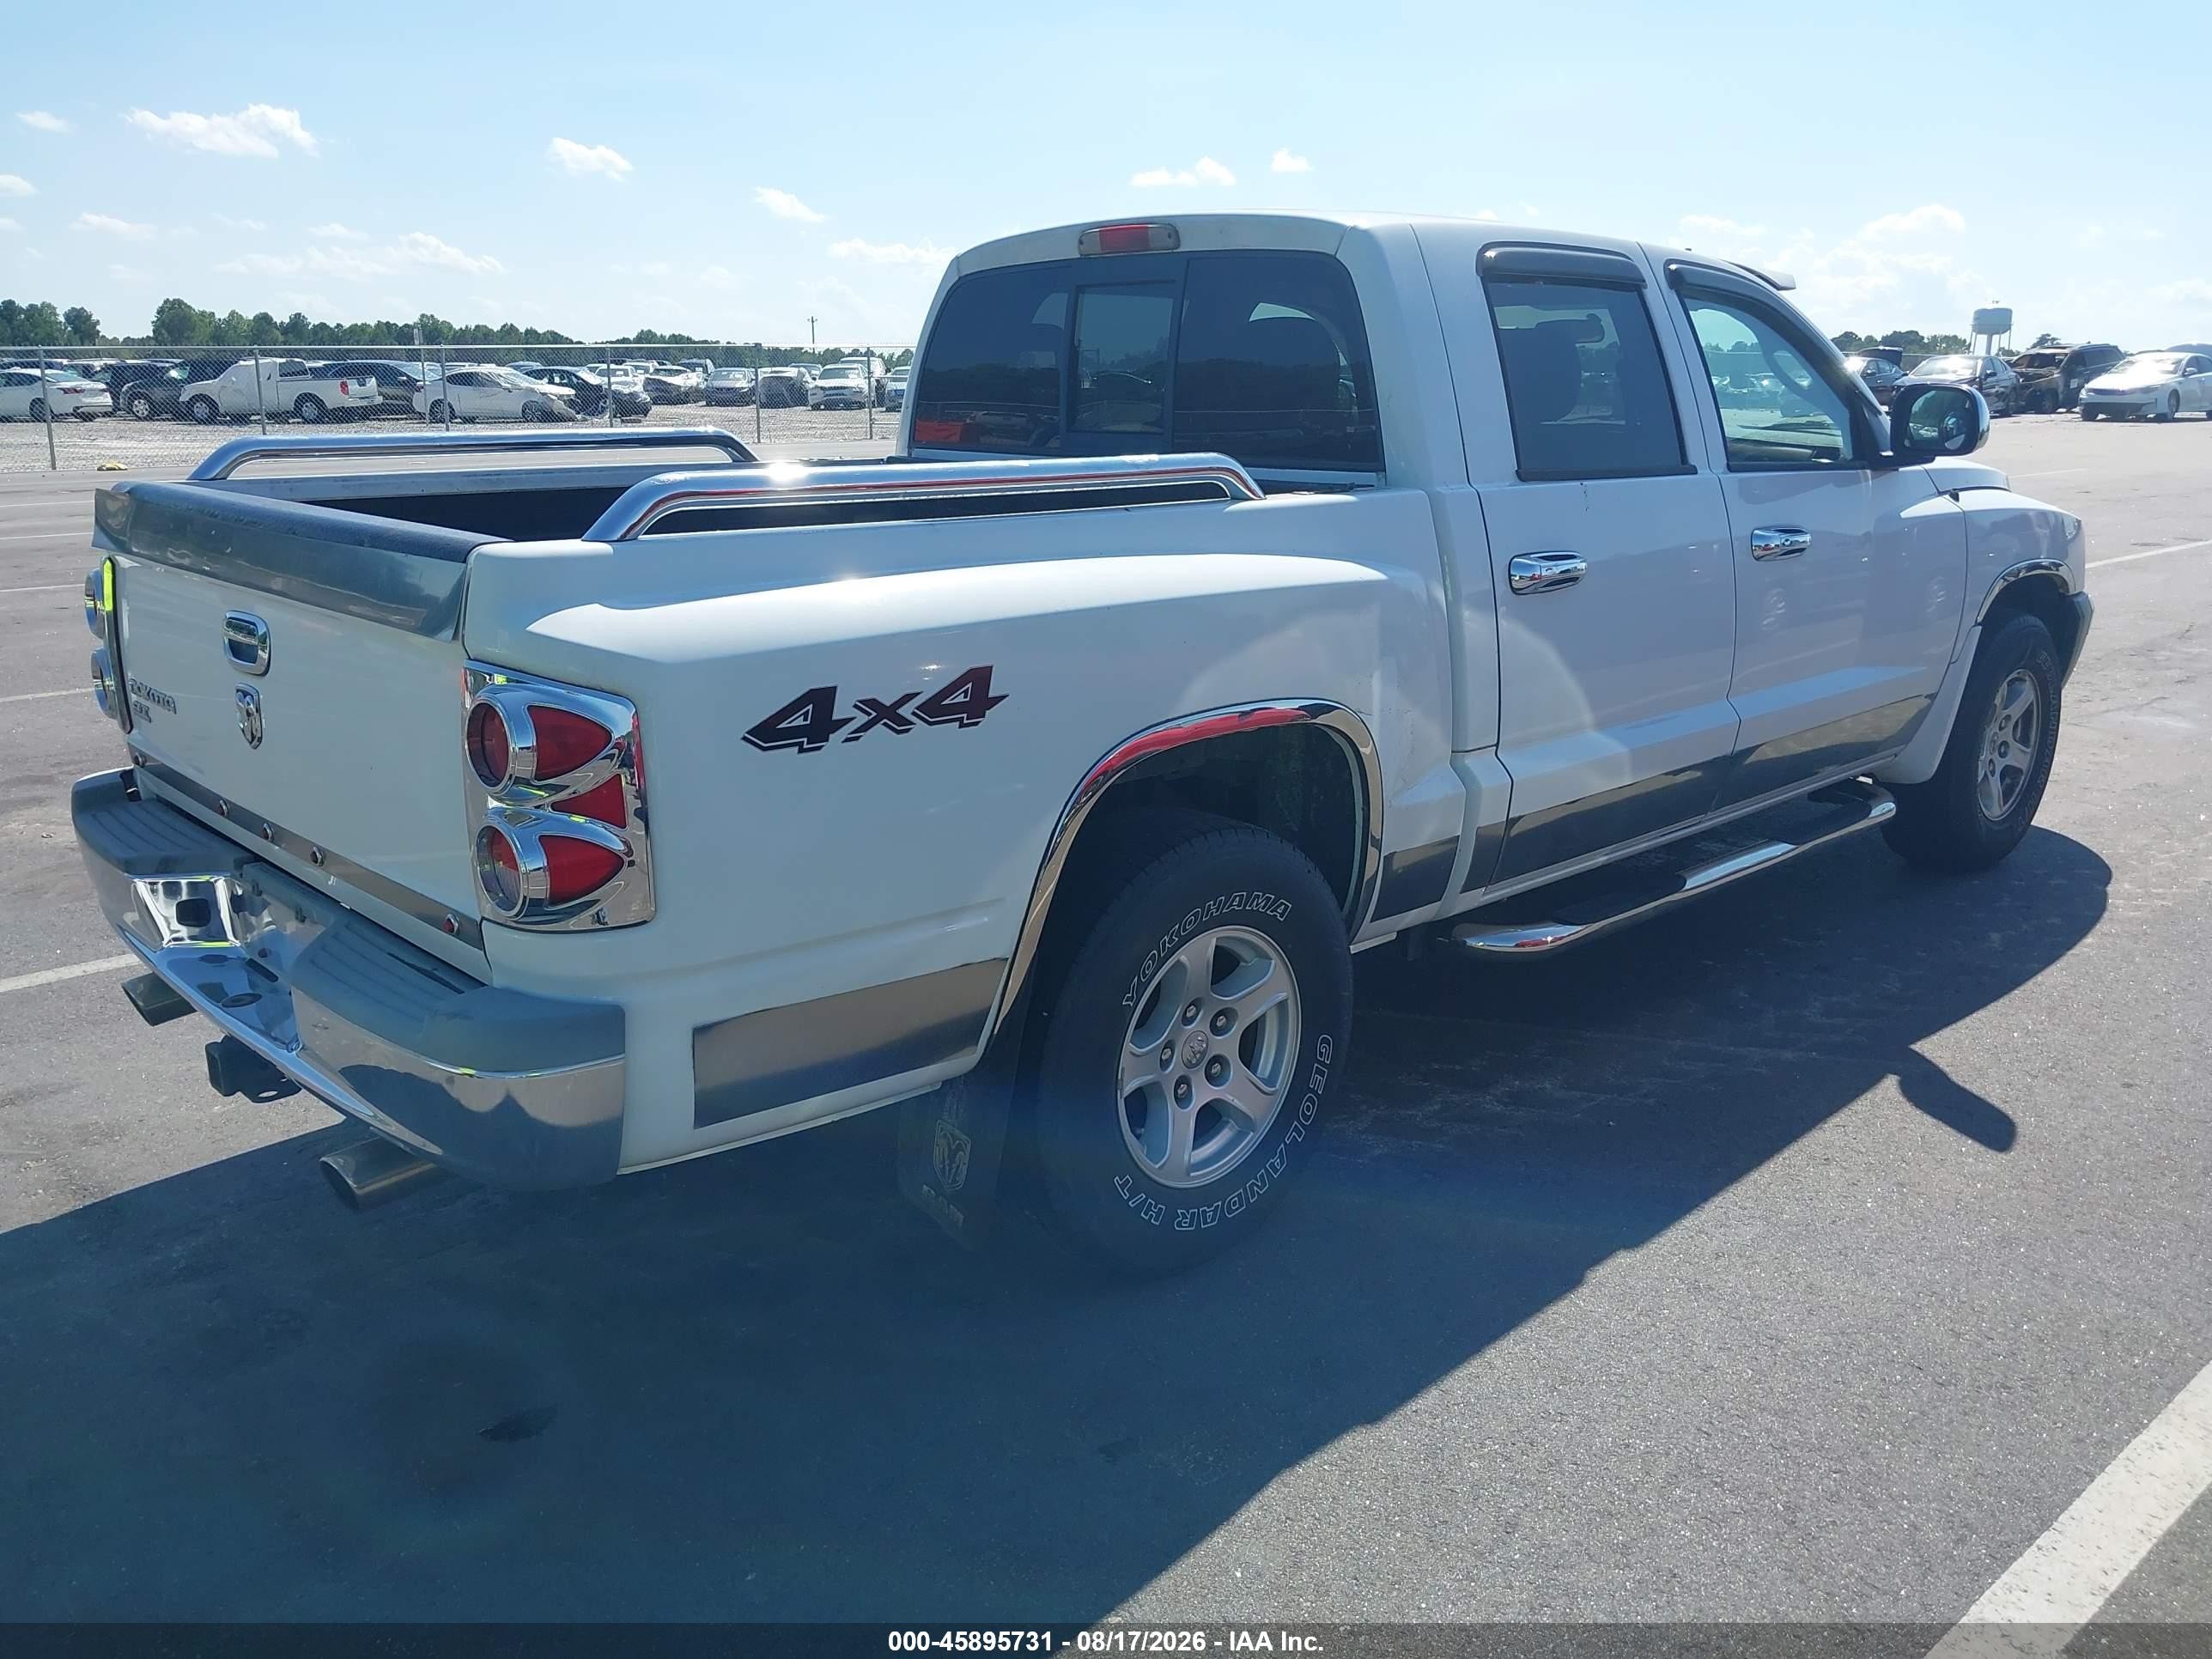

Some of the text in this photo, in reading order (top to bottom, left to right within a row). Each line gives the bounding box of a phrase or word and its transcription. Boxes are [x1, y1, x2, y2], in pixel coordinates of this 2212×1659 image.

[741, 665, 1011, 755] 4x4
[1122, 891, 1292, 1008] YOKOHAMA
[1114, 1034, 1334, 1231] GEOLANDAR H/T
